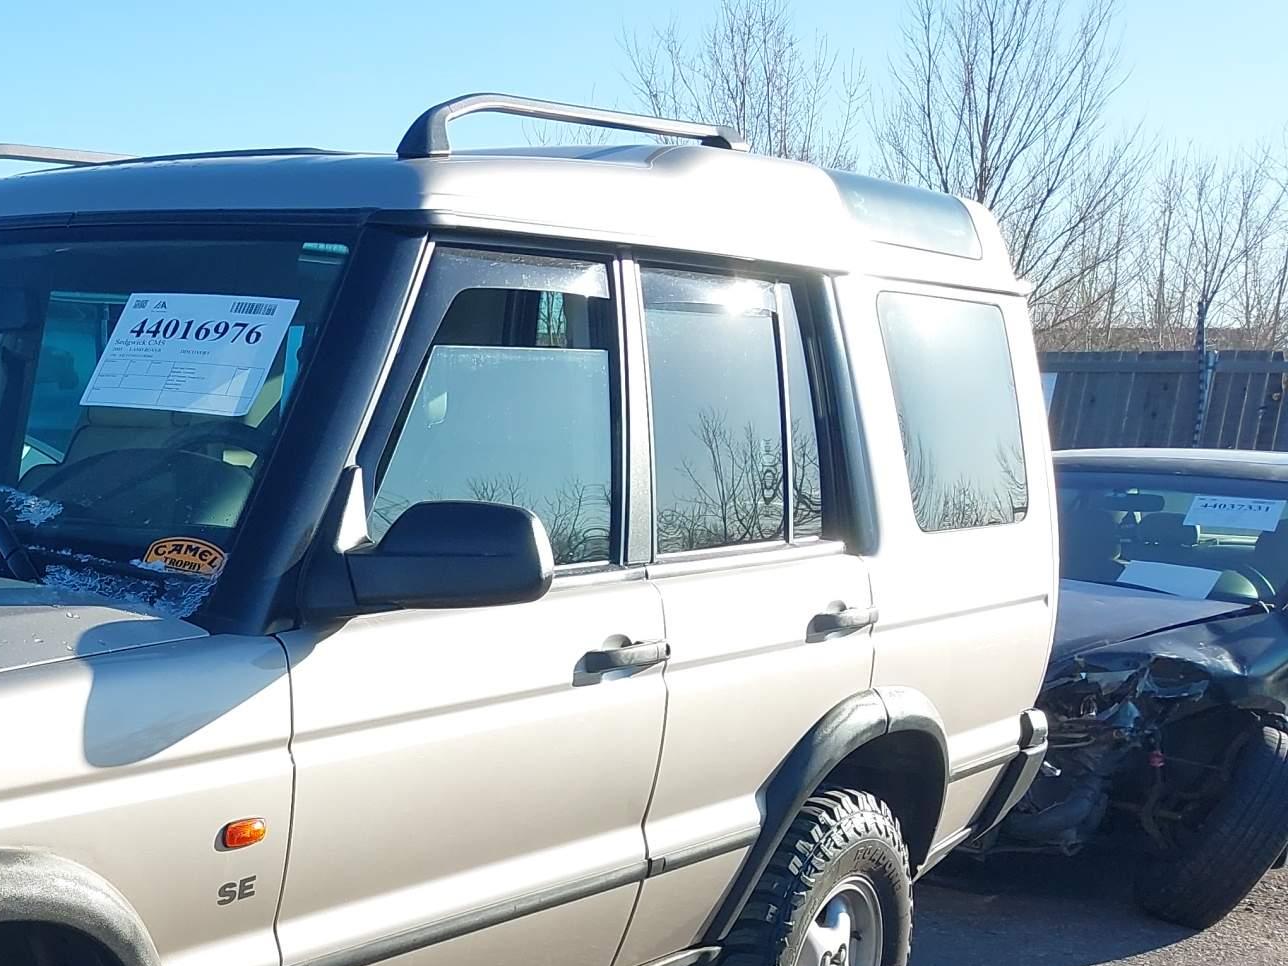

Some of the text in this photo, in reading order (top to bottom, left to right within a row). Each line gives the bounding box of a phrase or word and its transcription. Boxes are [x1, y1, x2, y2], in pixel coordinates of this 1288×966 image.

[114, 339, 145, 347] Sedgwick
[130, 318, 267, 345] 44016976
[154, 543, 219, 569] CAMEL
[164, 556, 202, 571] TROPHY
[217, 875, 257, 905] SE
